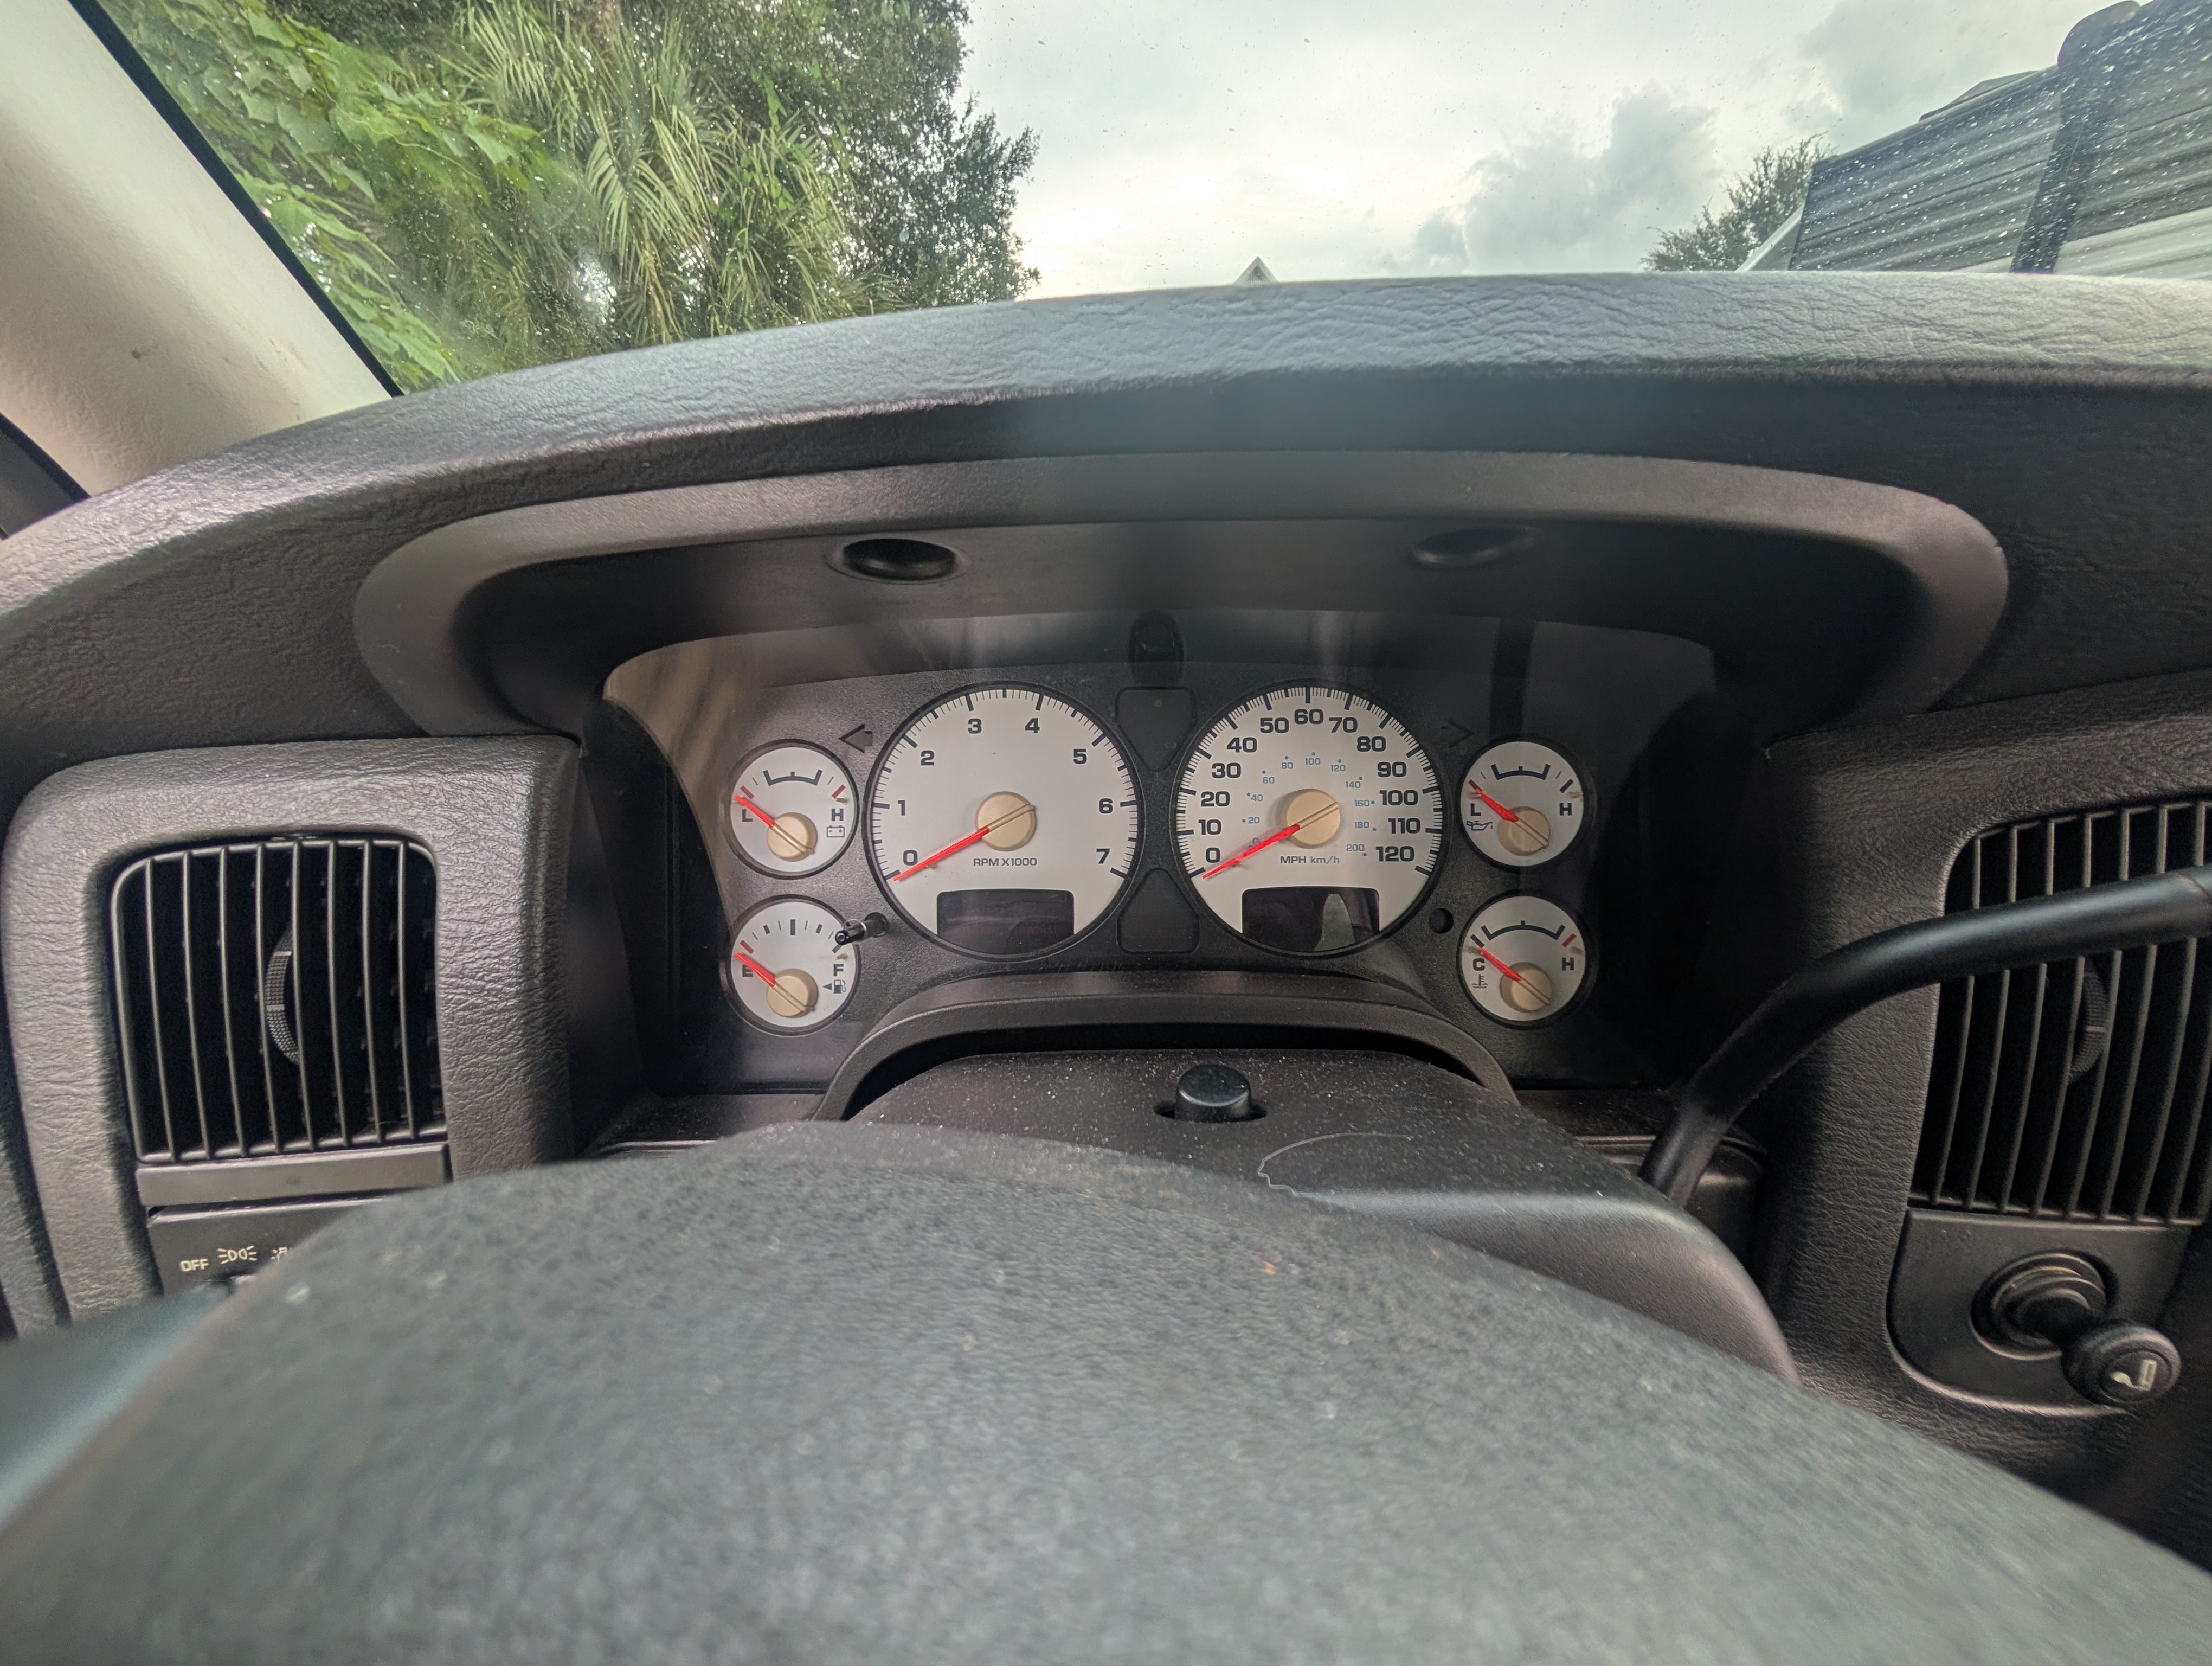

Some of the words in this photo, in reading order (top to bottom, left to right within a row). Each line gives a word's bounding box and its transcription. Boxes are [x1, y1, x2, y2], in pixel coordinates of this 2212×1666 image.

[1294, 709, 1323, 725] 60
[968, 719, 982, 734] 3
[1025, 718, 1040, 733] 4
[1259, 717, 1289, 733] 50
[1329, 717, 1358, 733] 70
[1226, 737, 1257, 753] 40
[1356, 736, 1386, 752] 80
[921, 751, 935, 766] 2
[1073, 749, 1088, 765] 5
[1211, 762, 1241, 778] 30
[1377, 762, 1406, 777] 90
[1200, 791, 1230, 807] 20
[1380, 790, 1418, 805] 100
[898, 800, 906, 816] 1
[1099, 798, 1113, 814] 6
[1470, 803, 1481, 816] L
[1559, 803, 1572, 816] H
[742, 809, 753, 822] L
[831, 808, 844, 821] H
[1198, 819, 1221, 835] 10
[1388, 818, 1420, 834] 110
[903, 850, 918, 866] 0
[1096, 849, 1110, 863] 7
[1205, 848, 1220, 863] 0
[1310, 855, 1340, 864] km/h
[1375, 846, 1414, 861] 120
[742, 964, 753, 977] E
[833, 964, 844, 976] F
[1472, 958, 1485, 971] C
[1562, 958, 1574, 971] H
[179, 1258, 209, 1272] OFF
